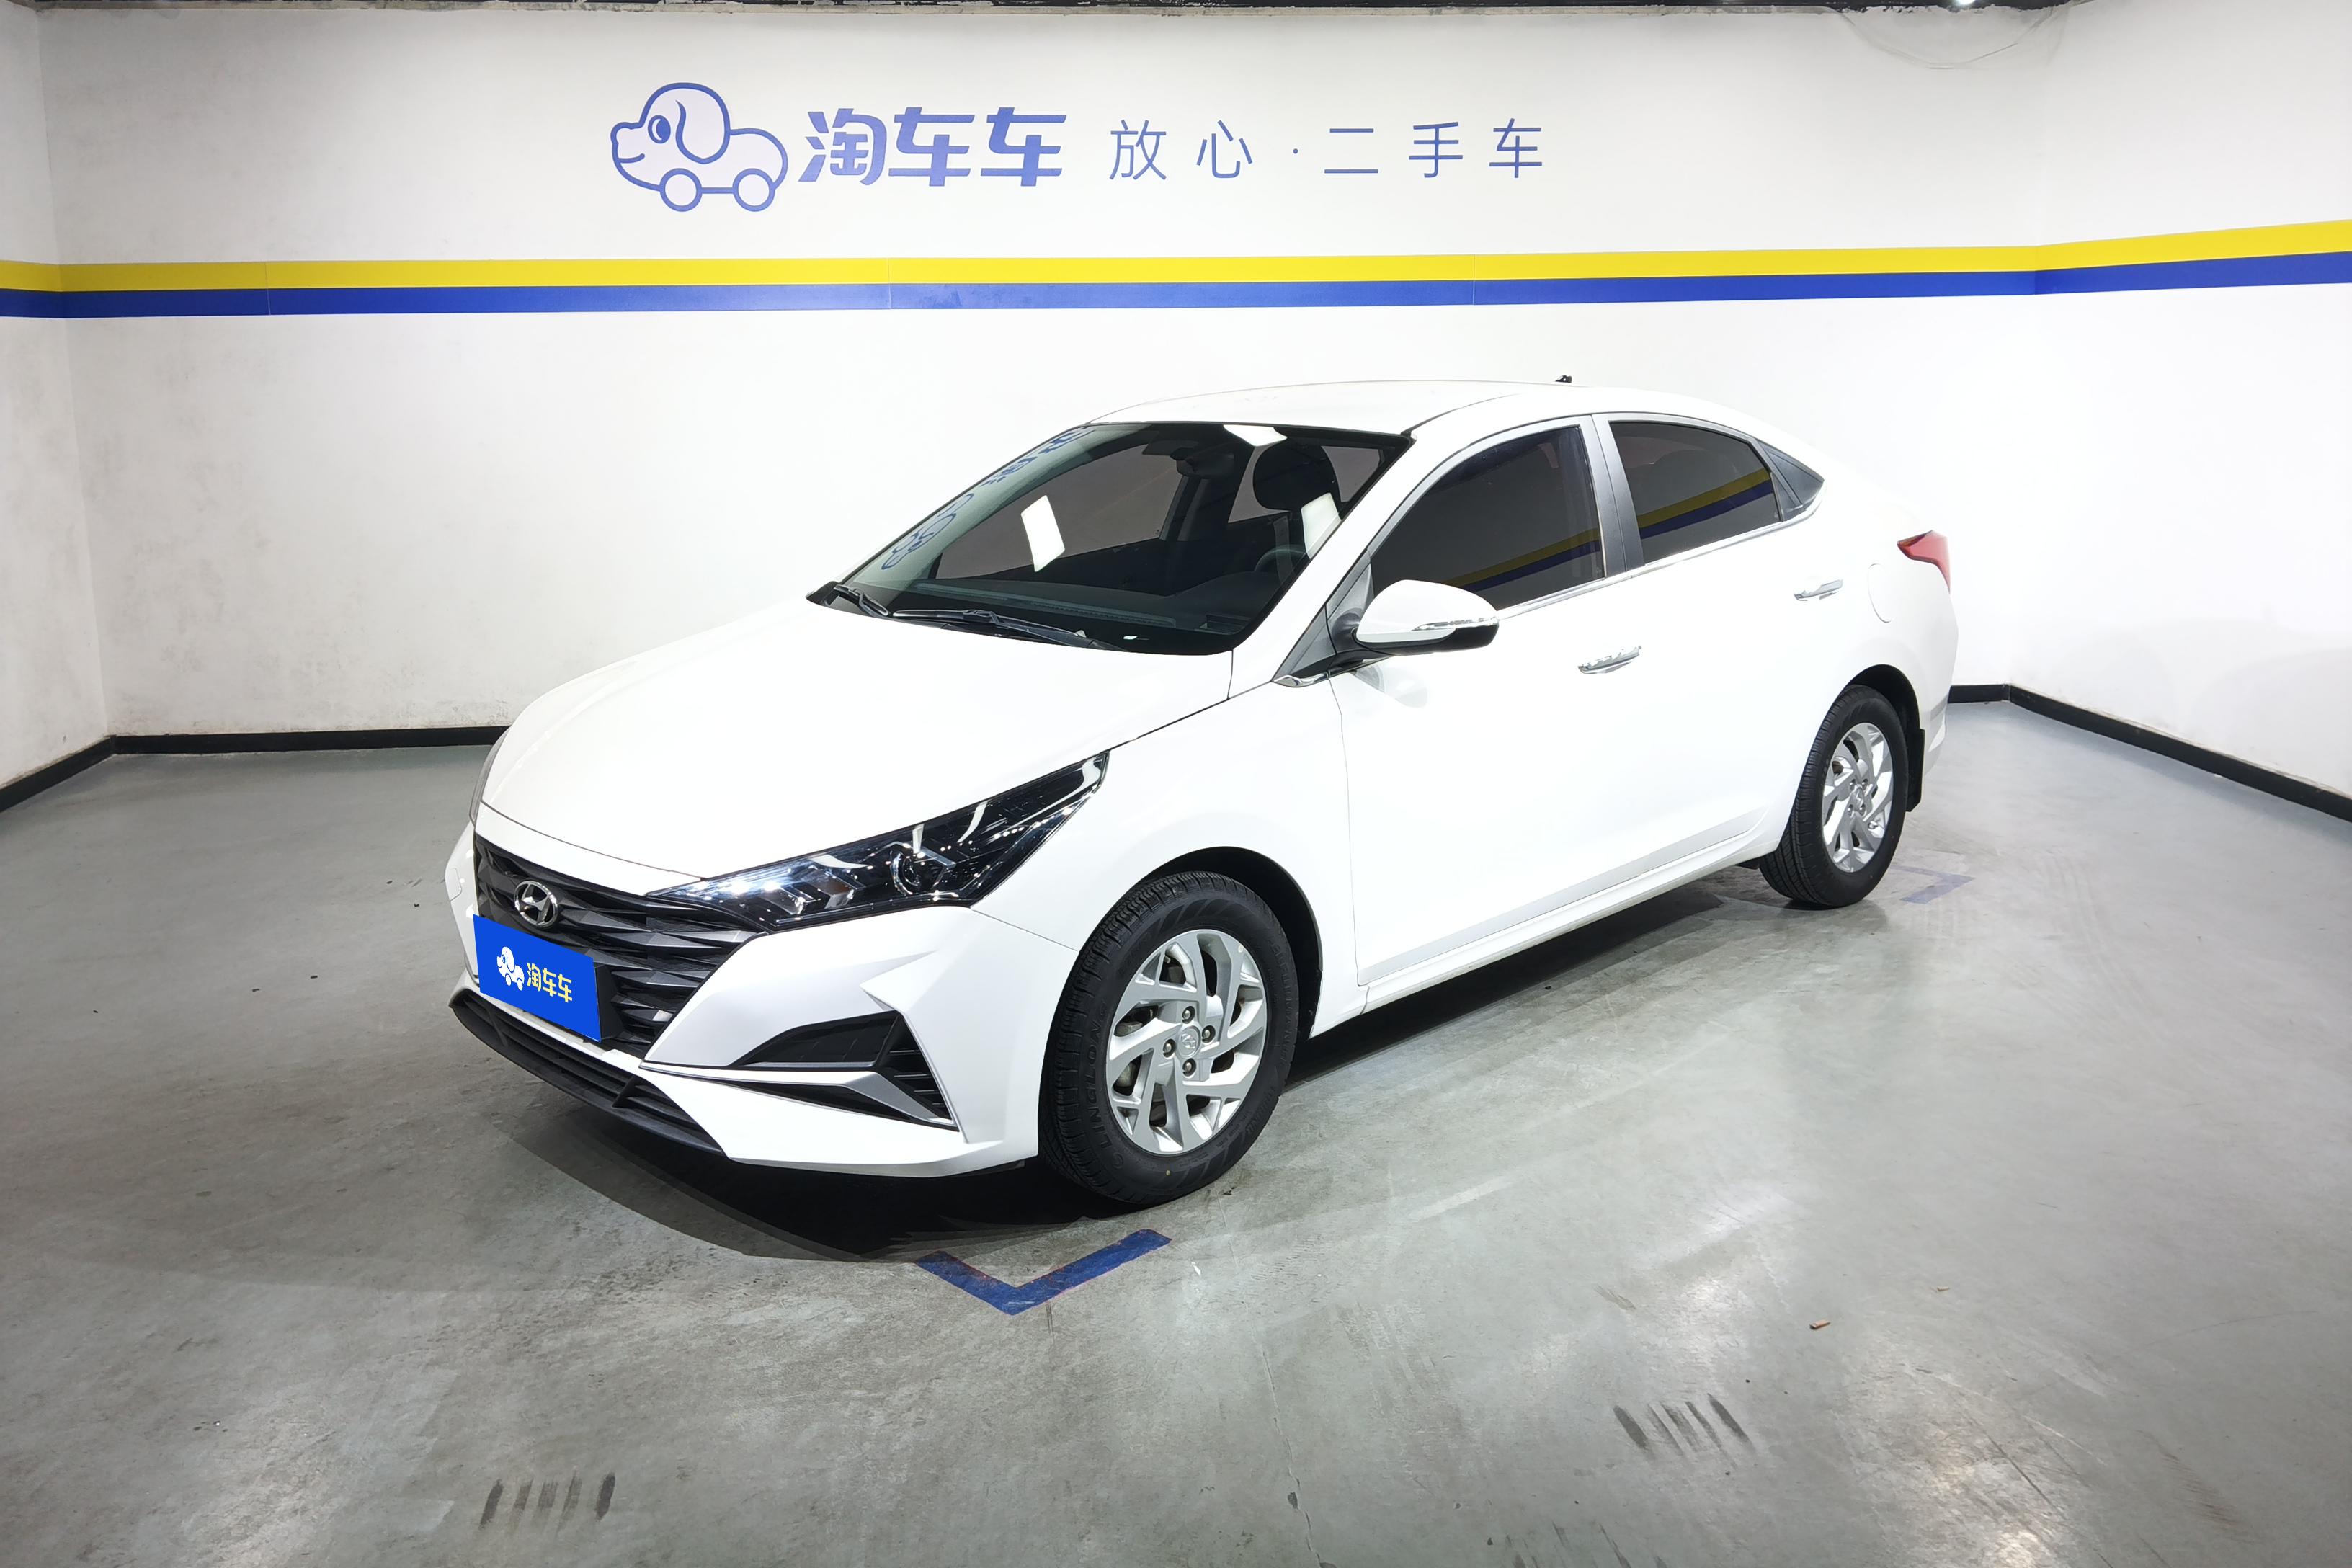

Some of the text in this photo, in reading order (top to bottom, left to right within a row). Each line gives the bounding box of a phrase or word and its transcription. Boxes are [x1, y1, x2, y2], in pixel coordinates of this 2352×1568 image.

[798, 107, 1067, 187] 淘车车
[1084, 999, 1113, 1149] LINGLONG
